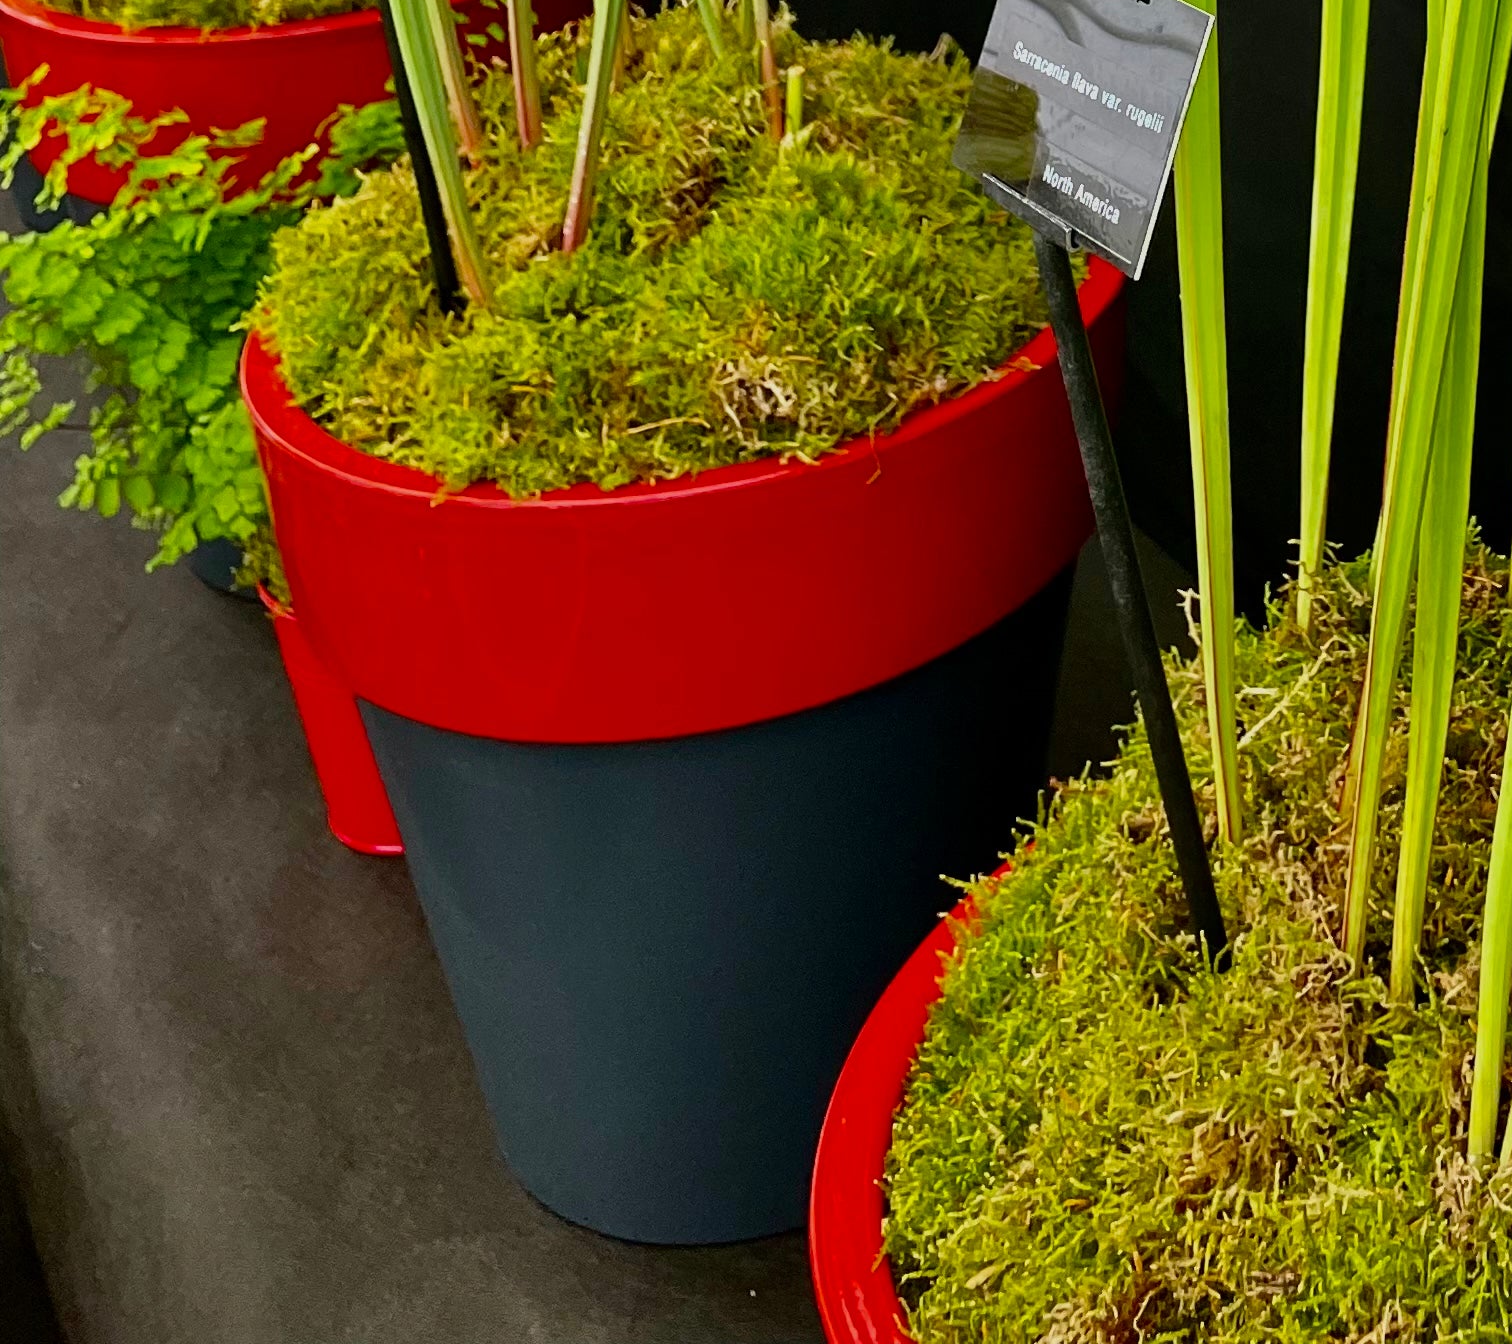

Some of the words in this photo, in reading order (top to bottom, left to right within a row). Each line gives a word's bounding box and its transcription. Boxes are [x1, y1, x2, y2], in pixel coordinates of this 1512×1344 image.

[1013, 40, 1070, 85] Sarracenia
[1071, 71, 1099, 100] flava
[1101, 90, 1122, 113] var.
[1126, 103, 1165, 134] rugelii
[1042, 164, 1073, 196] North
[1074, 183, 1120, 224] America
